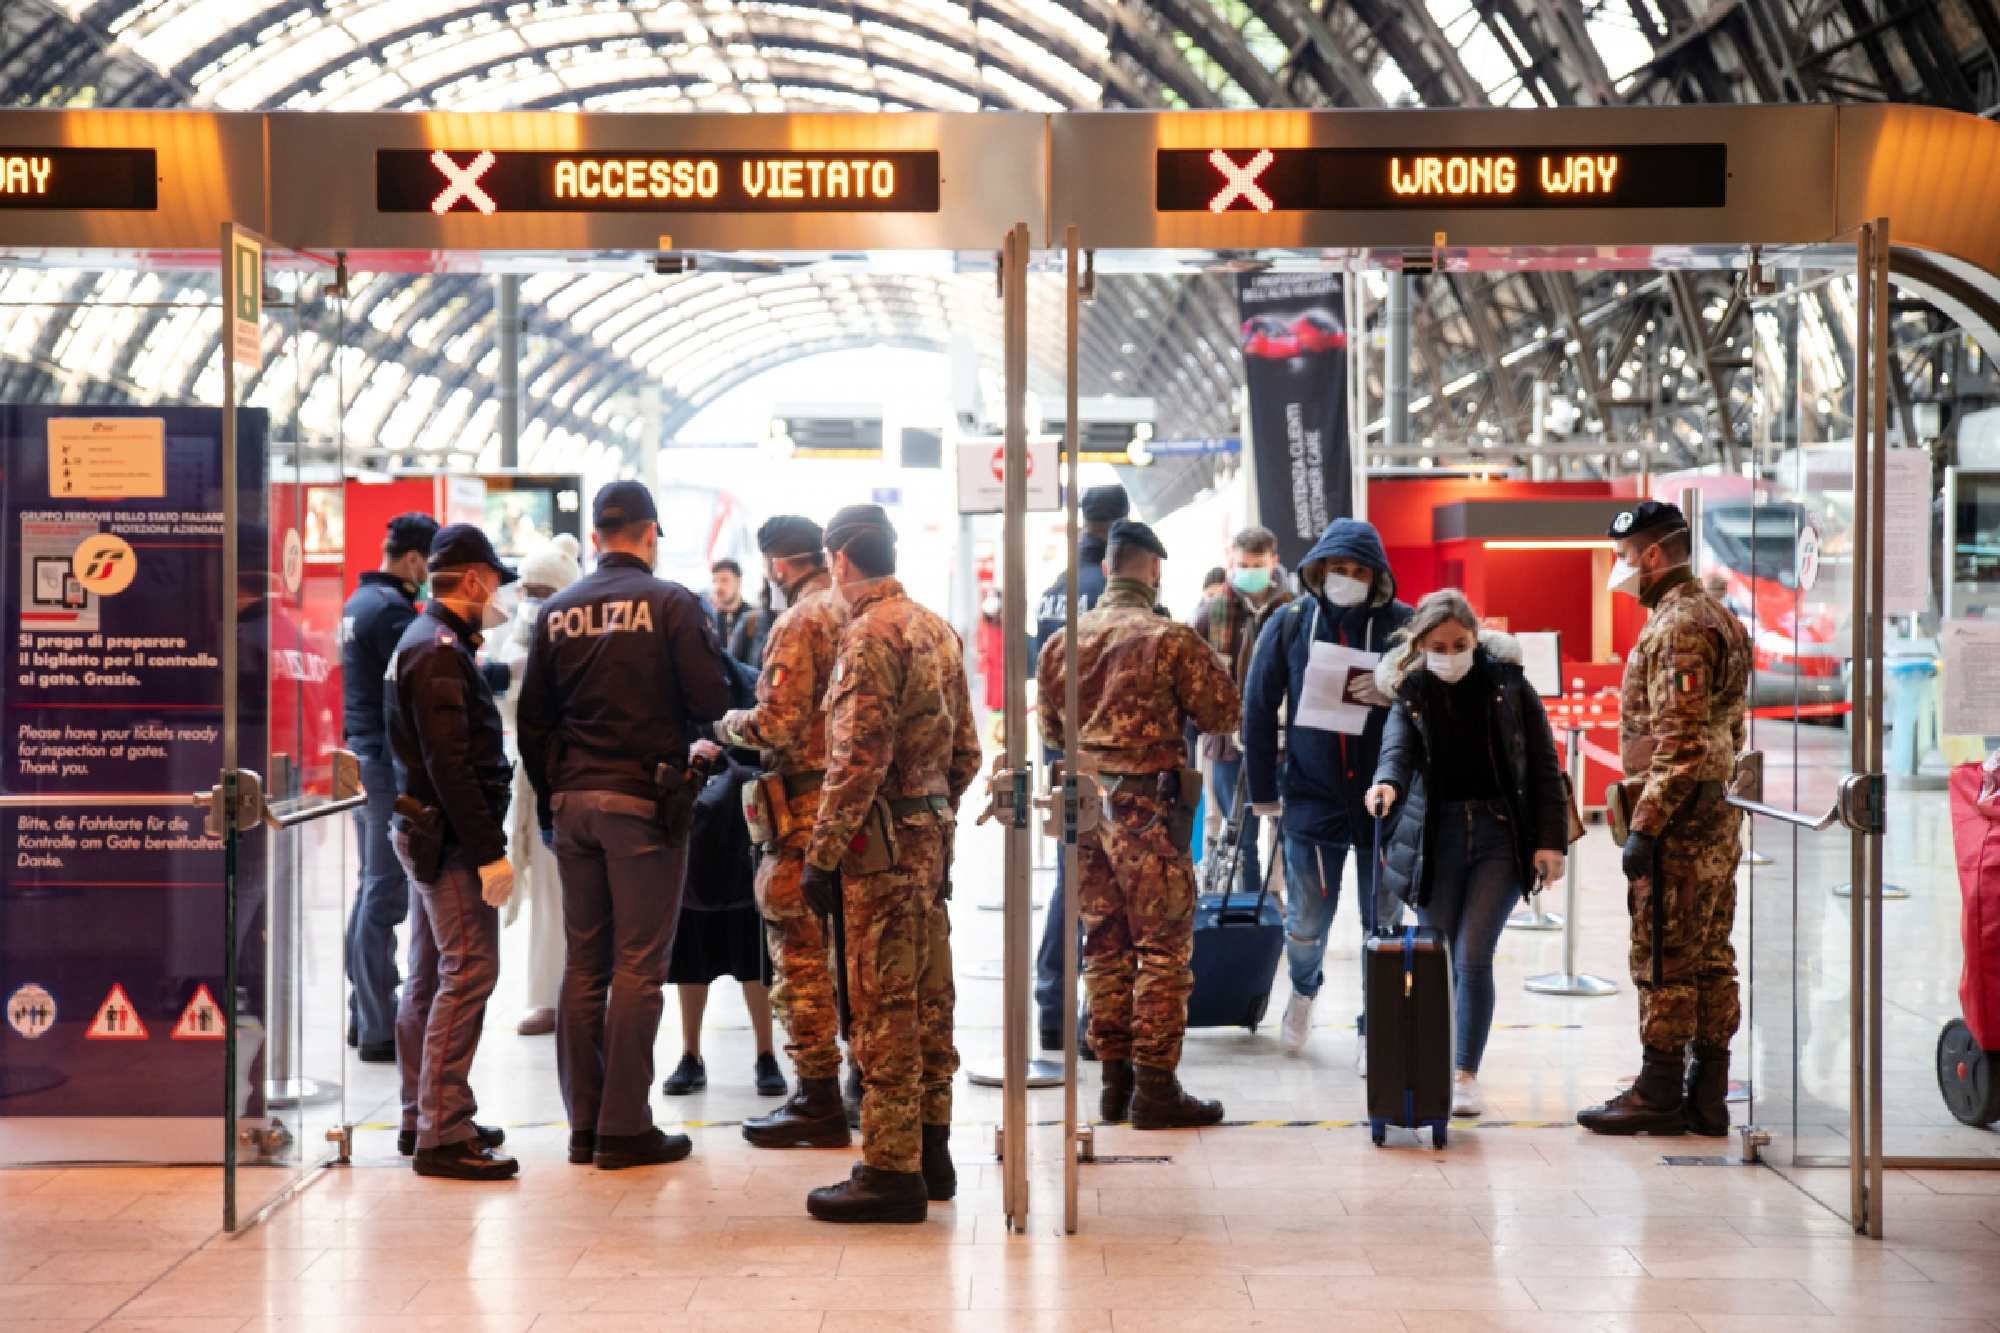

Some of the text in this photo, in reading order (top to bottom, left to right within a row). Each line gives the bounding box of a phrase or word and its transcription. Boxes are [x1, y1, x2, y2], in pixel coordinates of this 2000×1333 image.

[554, 159, 895, 199] ACCESSO VIETATO
[1390, 155, 1619, 194] WRONG WAY
[1305, 430, 1323, 466] CARE
[1285, 402, 1312, 539] ASSISTENZA CLIENTI
[20, 511, 63, 522] GRUPPO
[65, 511, 111, 522] FERROVIE
[114, 511, 146, 522] DELLO
[148, 511, 179, 522] STATO
[111, 523, 170, 534] PROTEZIONE
[547, 600, 653, 643] POLIZIA
[19, 633, 187, 651] Si prega di preparare
[19, 652, 218, 670] il biglietto per il controllo
[18, 671, 142, 689] ai gate. Grazie.
[19, 724, 218, 743] Please have your tickets ready
[18, 741, 168, 760] for inspection at gates.
[19, 759, 89, 777] Thank you.
[18, 815, 189, 831] Bitte, die Fahrkarte für die
[18, 833, 77, 848] Kontrolle
[79, 838, 103, 848] am
[106, 834, 141, 848] Gate
[18, 852, 64, 867] Danke.
